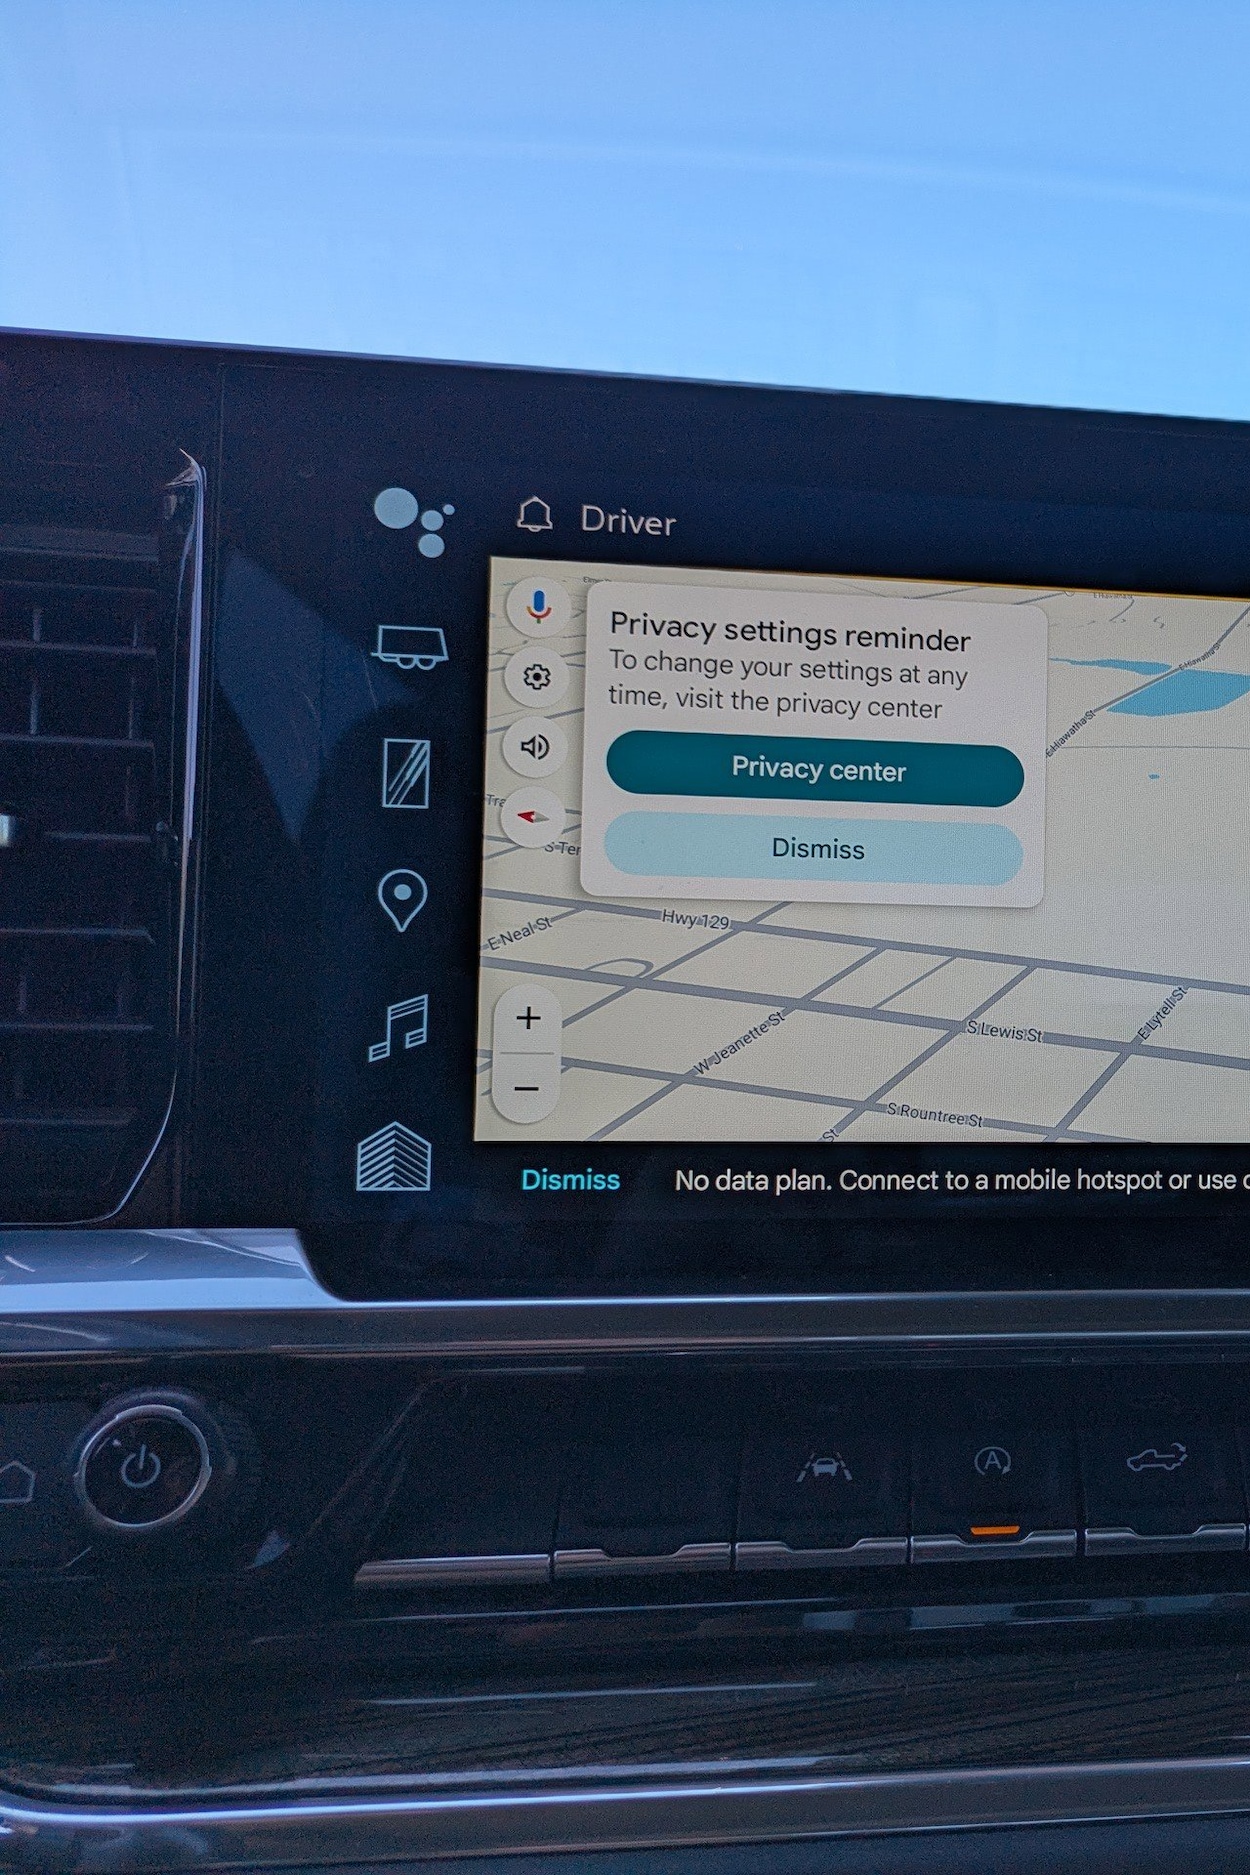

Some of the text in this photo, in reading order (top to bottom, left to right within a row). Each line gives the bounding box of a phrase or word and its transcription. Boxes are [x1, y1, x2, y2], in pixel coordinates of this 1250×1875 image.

[582, 504, 677, 537] Driver
[611, 611, 972, 652] Privacy settings reminder
[609, 649, 969, 691] To change your settings at any
[609, 683, 943, 721] time, visit the privacy center
[1051, 718, 1087, 752] Hiawatha
[1084, 709, 1097, 721] St
[732, 755, 907, 785] Privacy center
[772, 836, 866, 860] Dismiss
[487, 916, 553, 952] E Neal St
[661, 909, 730, 930] Hwy 129
[1137, 986, 1188, 1040] E Lytell St
[693, 1011, 785, 1075] W Jeanette St
[966, 1019, 1042, 1043] S Lewis St
[887, 1103, 983, 1129] S Rountree St
[521, 1167, 621, 1191] Dismiss
[675, 1169, 710, 1191] No
[714, 1168, 769, 1191] data
[775, 1167, 832, 1196] plan.
[838, 1168, 940, 1191] Connect
[945, 1170, 969, 1190] to
[974, 1174, 989, 1190] a
[994, 1168, 1071, 1190] mobile
[1077, 1168, 1163, 1195] hotspot
[1168, 1173, 1192, 1190] or
[1198, 1173, 1237, 1190] use
